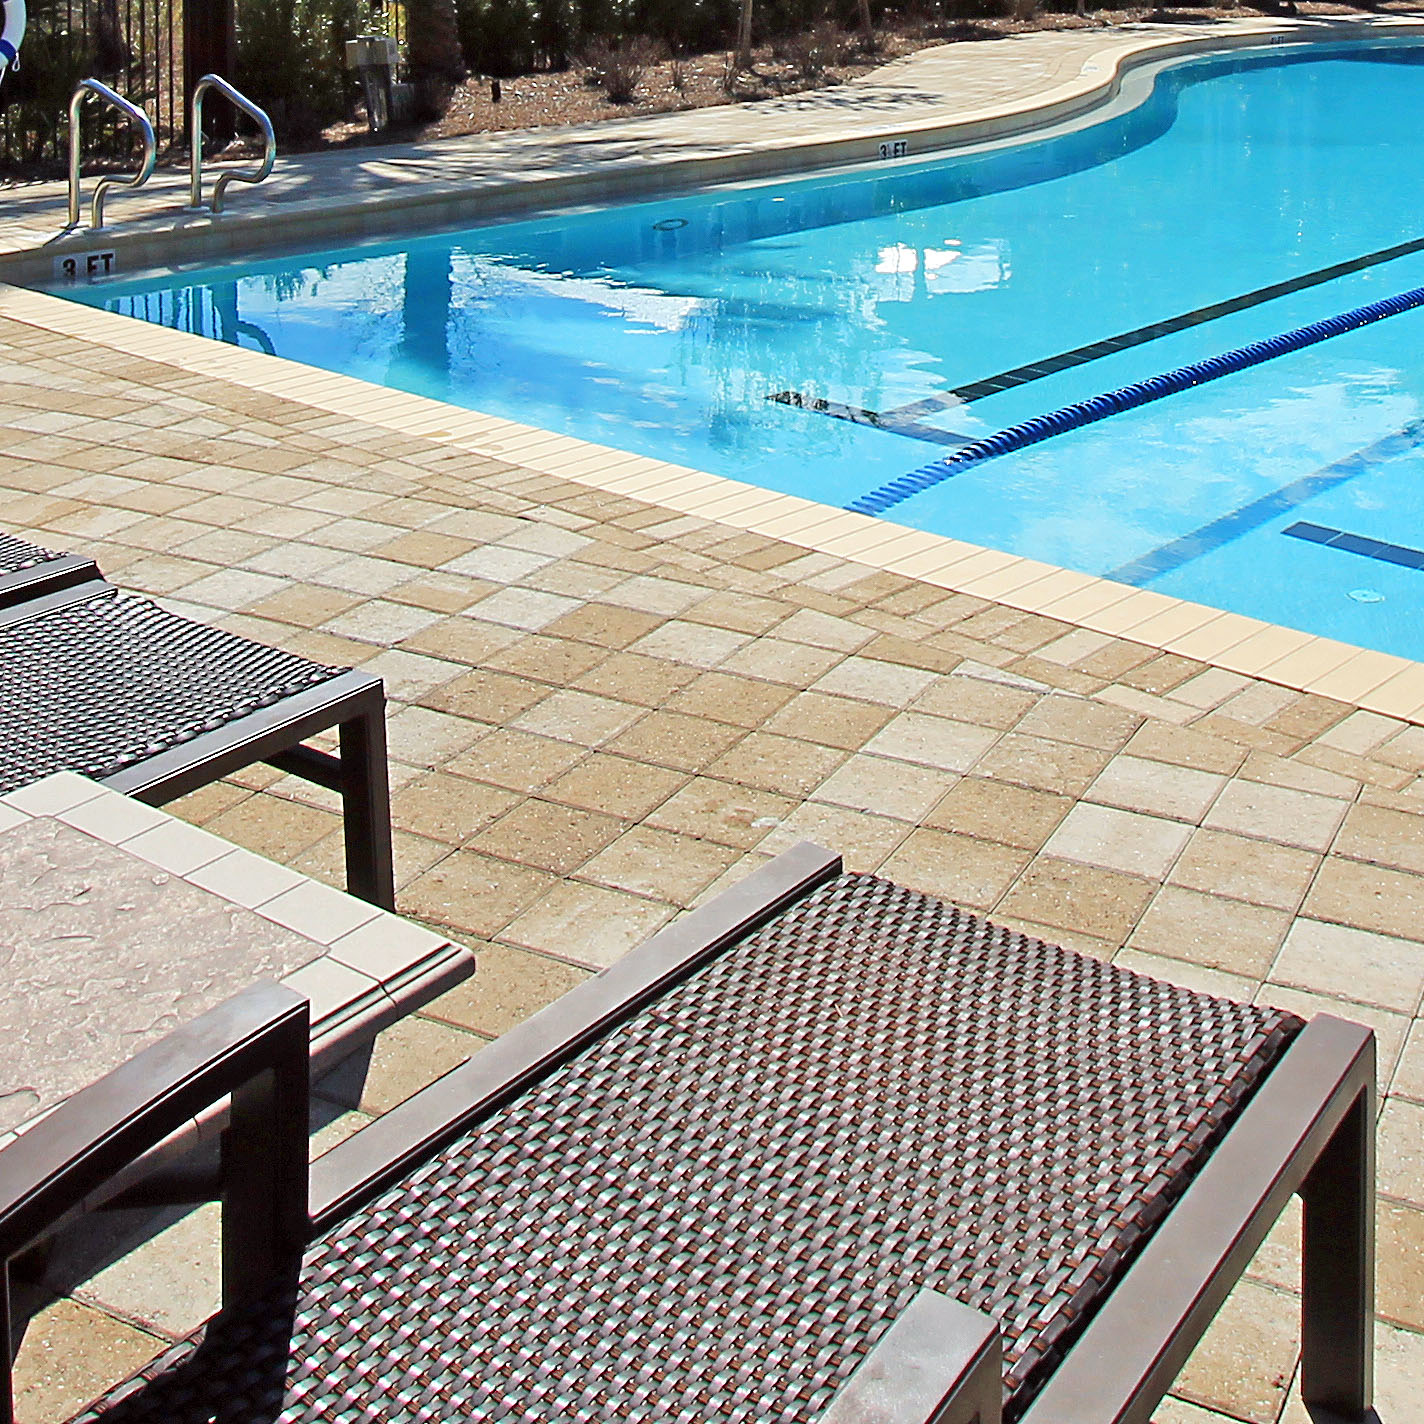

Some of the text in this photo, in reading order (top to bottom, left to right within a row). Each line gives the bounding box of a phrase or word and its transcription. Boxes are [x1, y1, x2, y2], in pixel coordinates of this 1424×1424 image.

[894, 141, 907, 155] FT
[62, 253, 114, 277] 3 FT
